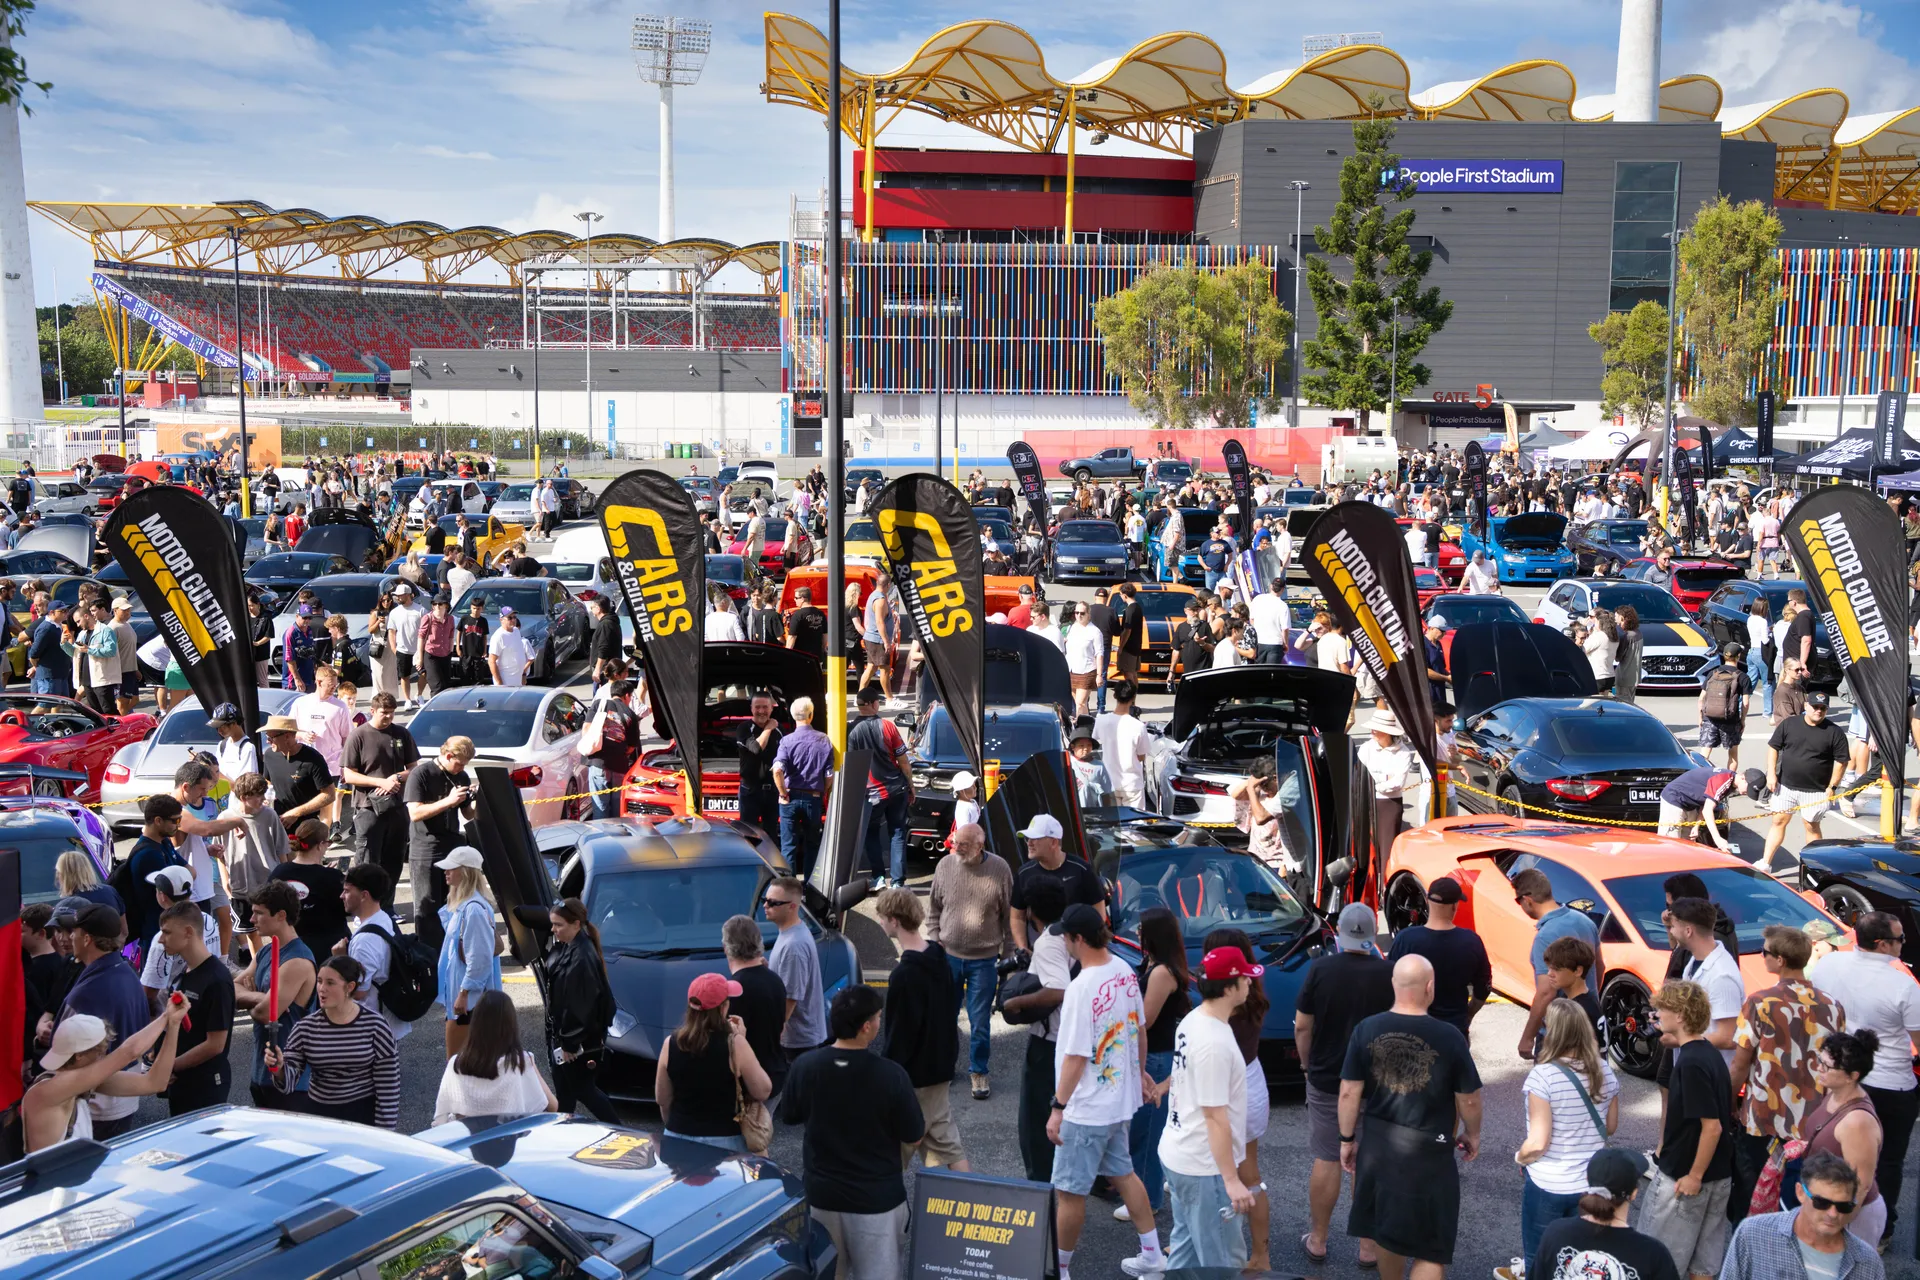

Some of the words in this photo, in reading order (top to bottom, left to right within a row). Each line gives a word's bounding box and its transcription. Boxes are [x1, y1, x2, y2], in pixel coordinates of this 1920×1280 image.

[1400, 168, 1453, 186] People
[1455, 168, 1489, 183] First
[1491, 168, 1554, 183] Stadium
[157, 321, 179, 339] Stadium
[160, 315, 177, 331] People
[176, 325, 188, 338] First
[1433, 392, 1470, 402] GATE
[1475, 384, 1492, 409] 5
[1436, 416, 1459, 424] People
[1884, 432, 1893, 460] CULTURE
[138, 512, 194, 578] MOTOR
[180, 572, 236, 650] CULTURE
[604, 504, 693, 636] CARS
[618, 560, 634, 577] &
[878, 508, 974, 638] CARS
[896, 564, 911, 579] &
[1328, 528, 1377, 594] MOTOR
[1366, 585, 1414, 662] CULTURE
[1818, 512, 1863, 580] MOTOR
[1845, 578, 1894, 658] CULTURE
[624, 577, 654, 642] CULTURE
[900, 580, 934, 644] CULTURE
[160, 611, 202, 666] AUSTRALIA
[1821, 612, 1852, 670] AUSTRALIA
[1350, 627, 1388, 681] AUSTRALIA
[926, 1197, 956, 1216] WHAT
[955, 1201, 971, 1218] DO
[972, 1204, 992, 1222] YOU
[992, 1206, 1012, 1224] GET
[1012, 1209, 1028, 1226] AS
[1026, 1212, 1036, 1228] A
[945, 1220, 962, 1238] VIP
[962, 1224, 1014, 1245] MEMBER?
[966, 1247, 990, 1258] TODAY
[976, 1262, 994, 1270] coffee
[926, 1264, 952, 1274] Event-only
[953, 1268, 973, 1277] Scratch
[979, 1271, 990, 1279] Win
